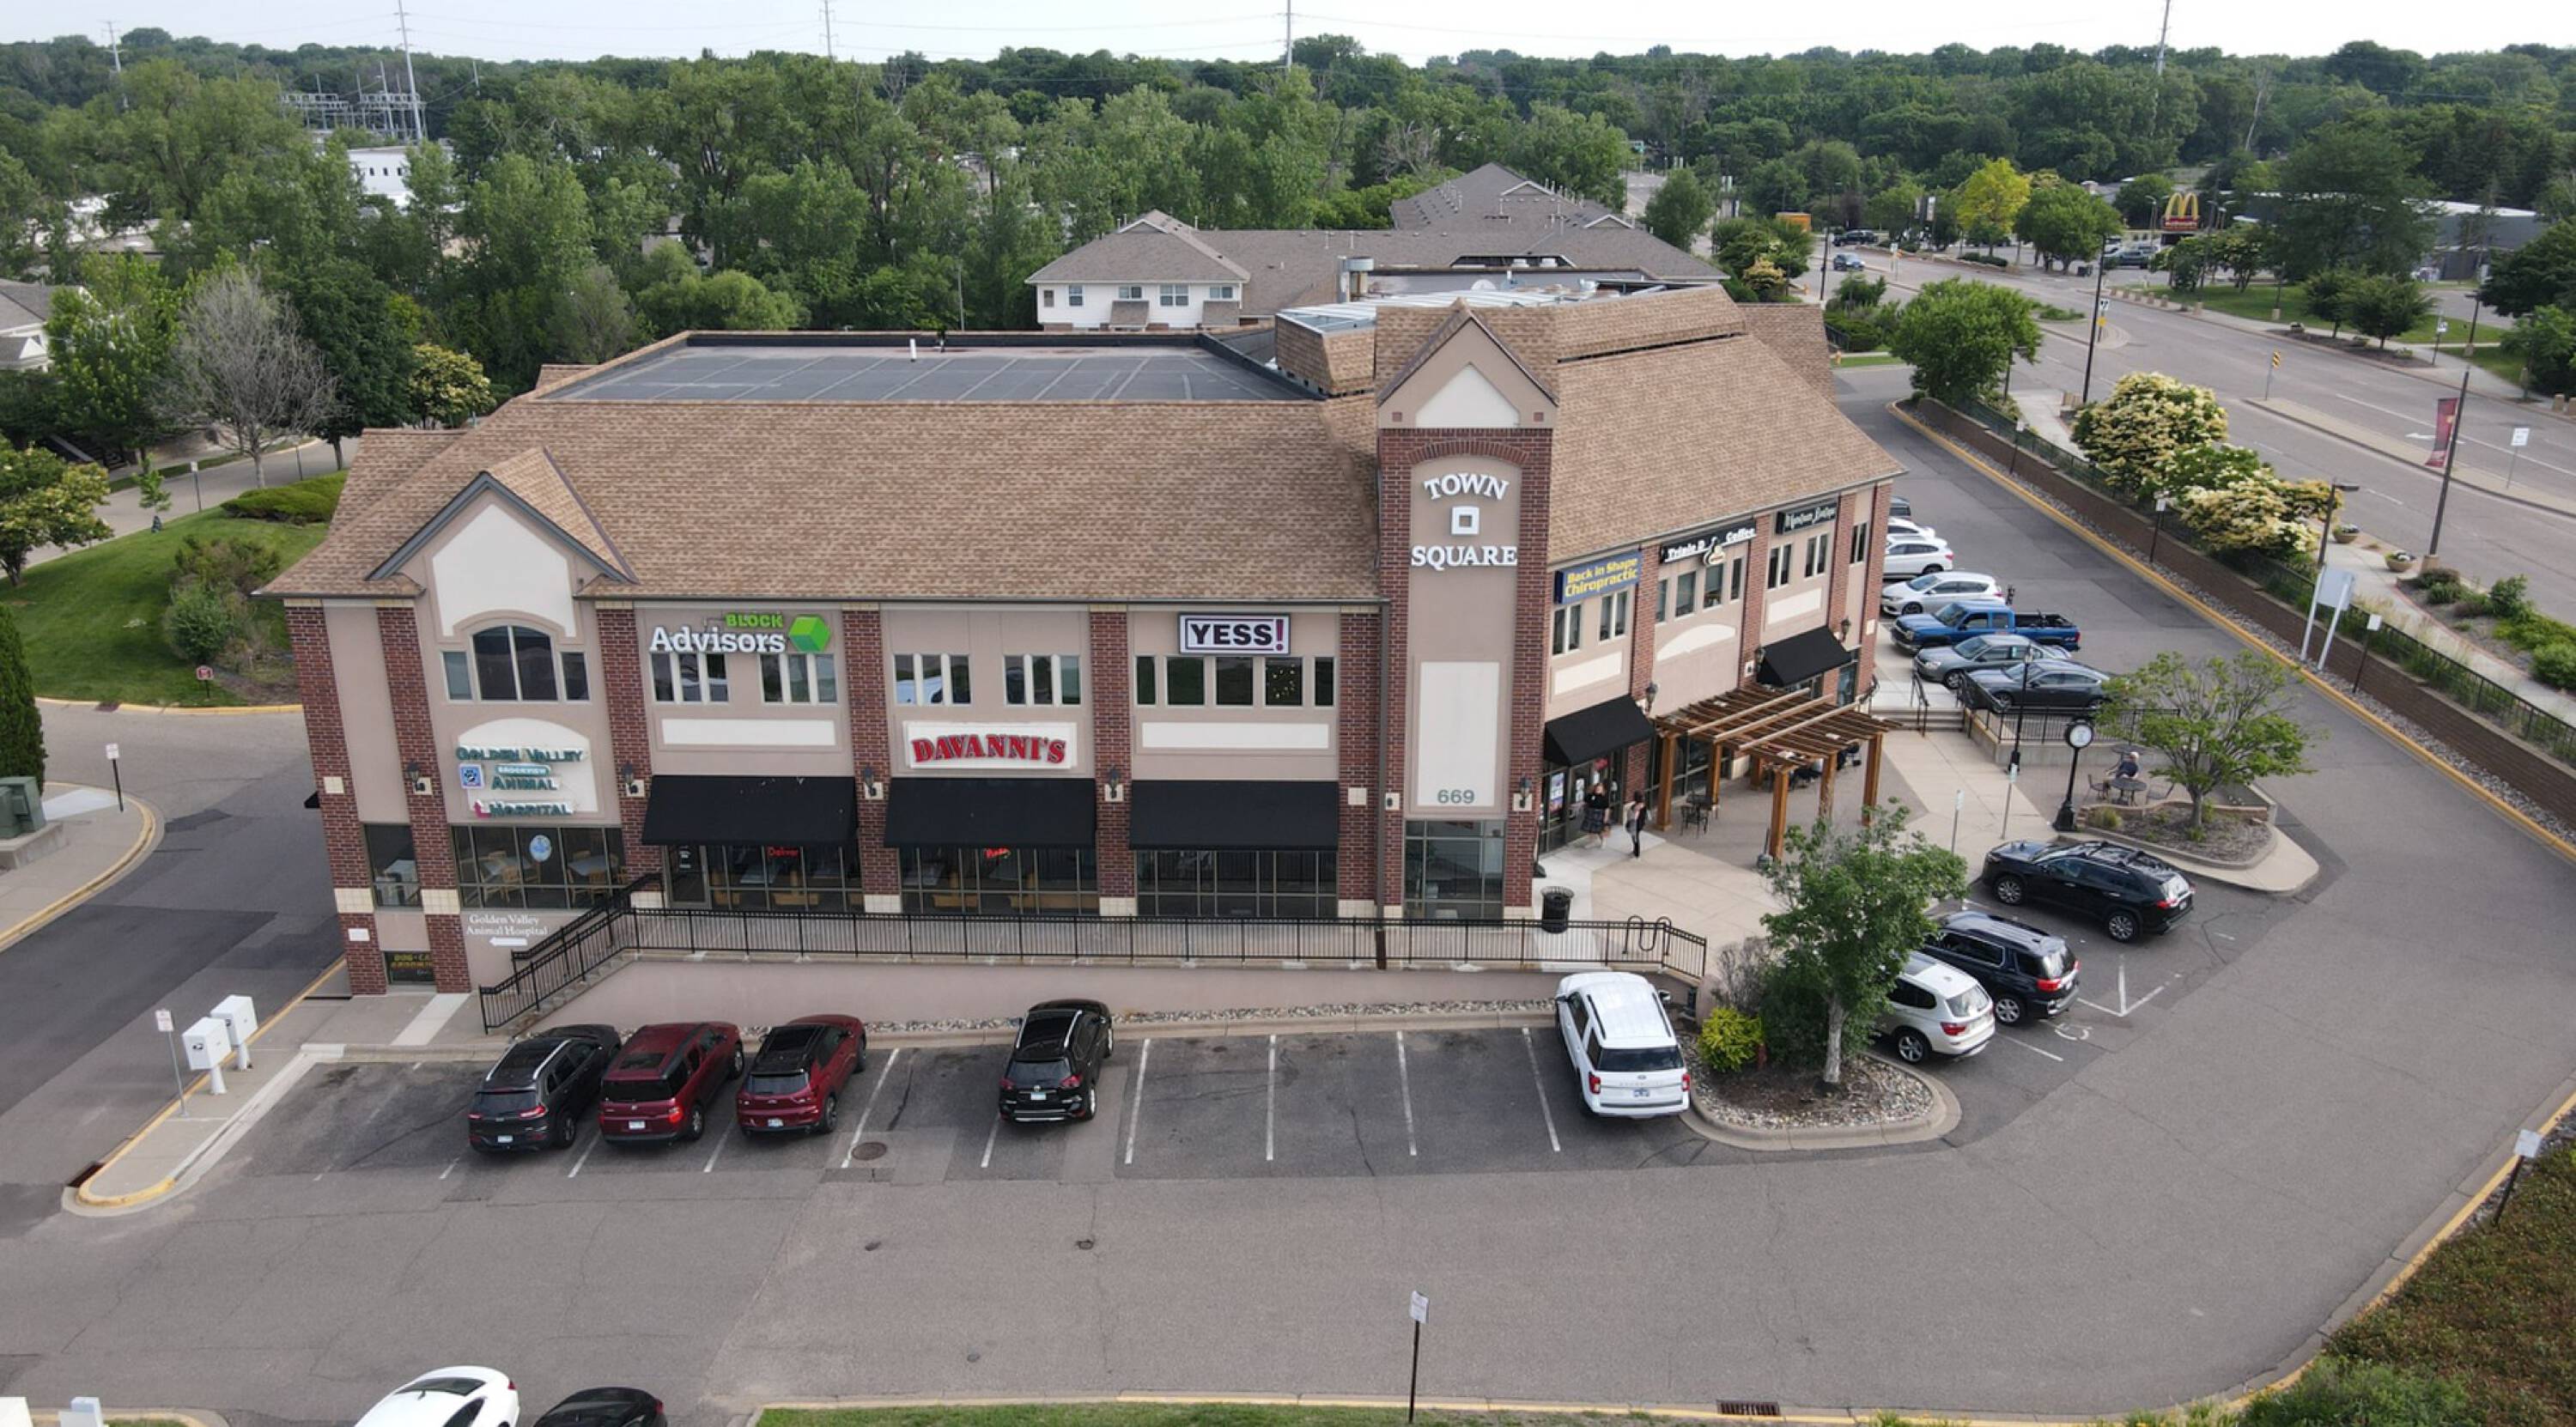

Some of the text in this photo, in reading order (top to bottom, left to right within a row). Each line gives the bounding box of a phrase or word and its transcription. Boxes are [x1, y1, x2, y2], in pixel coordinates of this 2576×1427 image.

[1424, 472, 1510, 500] TOWN
[1411, 545, 1517, 571] SQUARE
[1567, 568, 1593, 583] Back
[1607, 558, 1637, 574] Shape
[1564, 568, 1637, 598] Chiropractic
[725, 612, 783, 628] BLOCK
[649, 625, 786, 653] Advisors
[1190, 618, 1285, 652] YESS!
[911, 733, 1066, 763] DAVANNI'S
[1437, 789, 1475, 805] 669
[466, 926, 548, 938] Animal Hospital
[469, 914, 539, 925] Golden Valley
